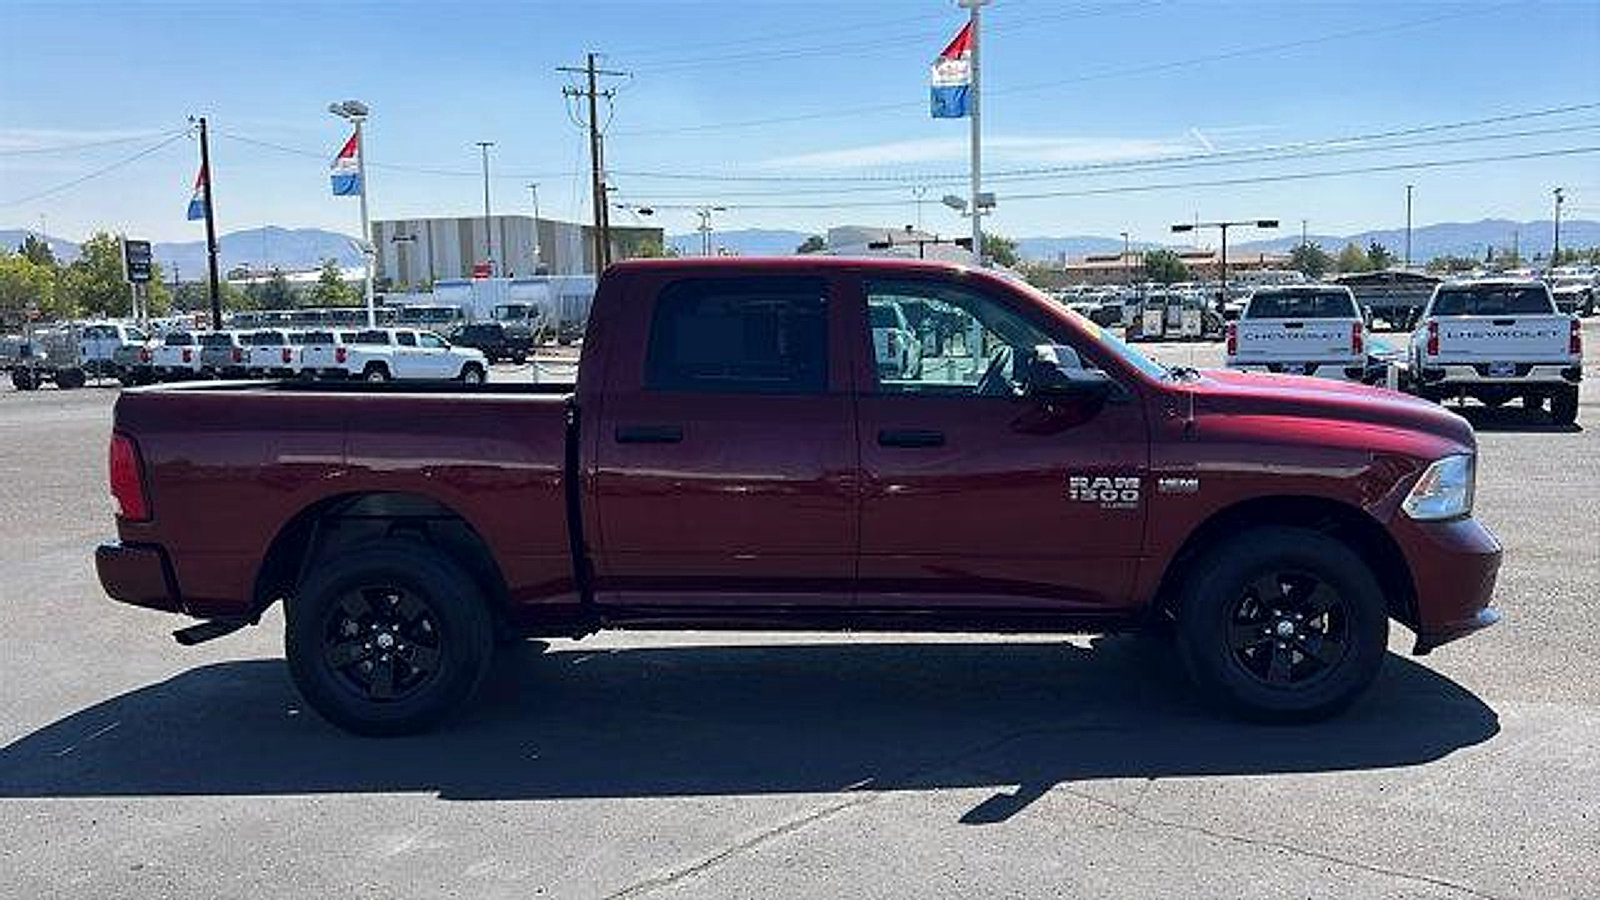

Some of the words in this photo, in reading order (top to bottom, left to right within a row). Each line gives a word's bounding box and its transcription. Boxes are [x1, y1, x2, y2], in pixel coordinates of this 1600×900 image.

[1244, 331, 1344, 341] CHEVROLET
[1446, 330, 1559, 340] CHEVROLET
[1069, 476, 1140, 489] RAM
[1069, 489, 1140, 501] 1500
